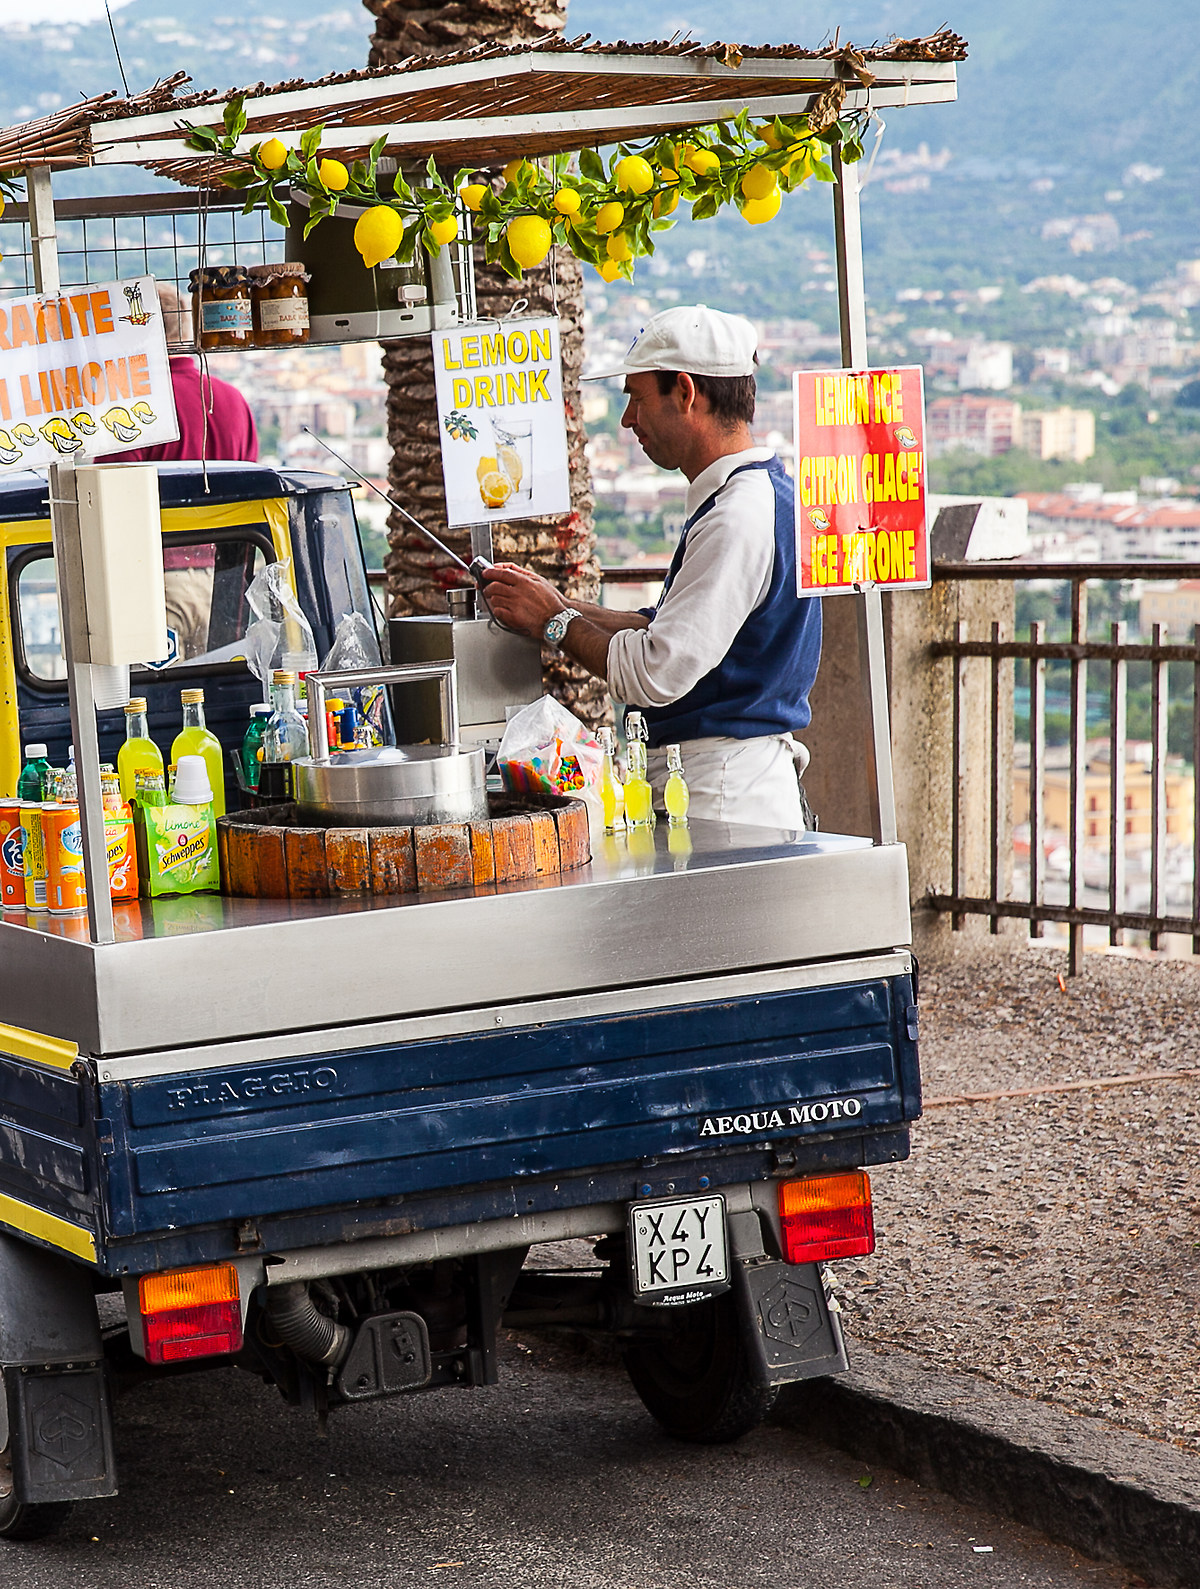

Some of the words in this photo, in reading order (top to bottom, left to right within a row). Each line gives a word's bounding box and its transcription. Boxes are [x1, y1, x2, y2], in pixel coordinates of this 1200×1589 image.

[442, 328, 552, 370] LEMON
[20, 353, 152, 418] LIMONE
[452, 368, 552, 409] DRINK
[815, 376, 870, 426] LEMON
[872, 373, 904, 424] ICE
[800, 454, 858, 507] CITRON
[810, 533, 838, 585] ICE
[841, 529, 916, 584] ZITRONE
[161, 838, 205, 869] Schweppes
[167, 1066, 338, 1108] PIAGGIO
[699, 1109, 785, 1136] AEQUA
[788, 1098, 861, 1125] MOTO
[647, 1206, 710, 1247] X4Y
[649, 1244, 714, 1285] KP4
